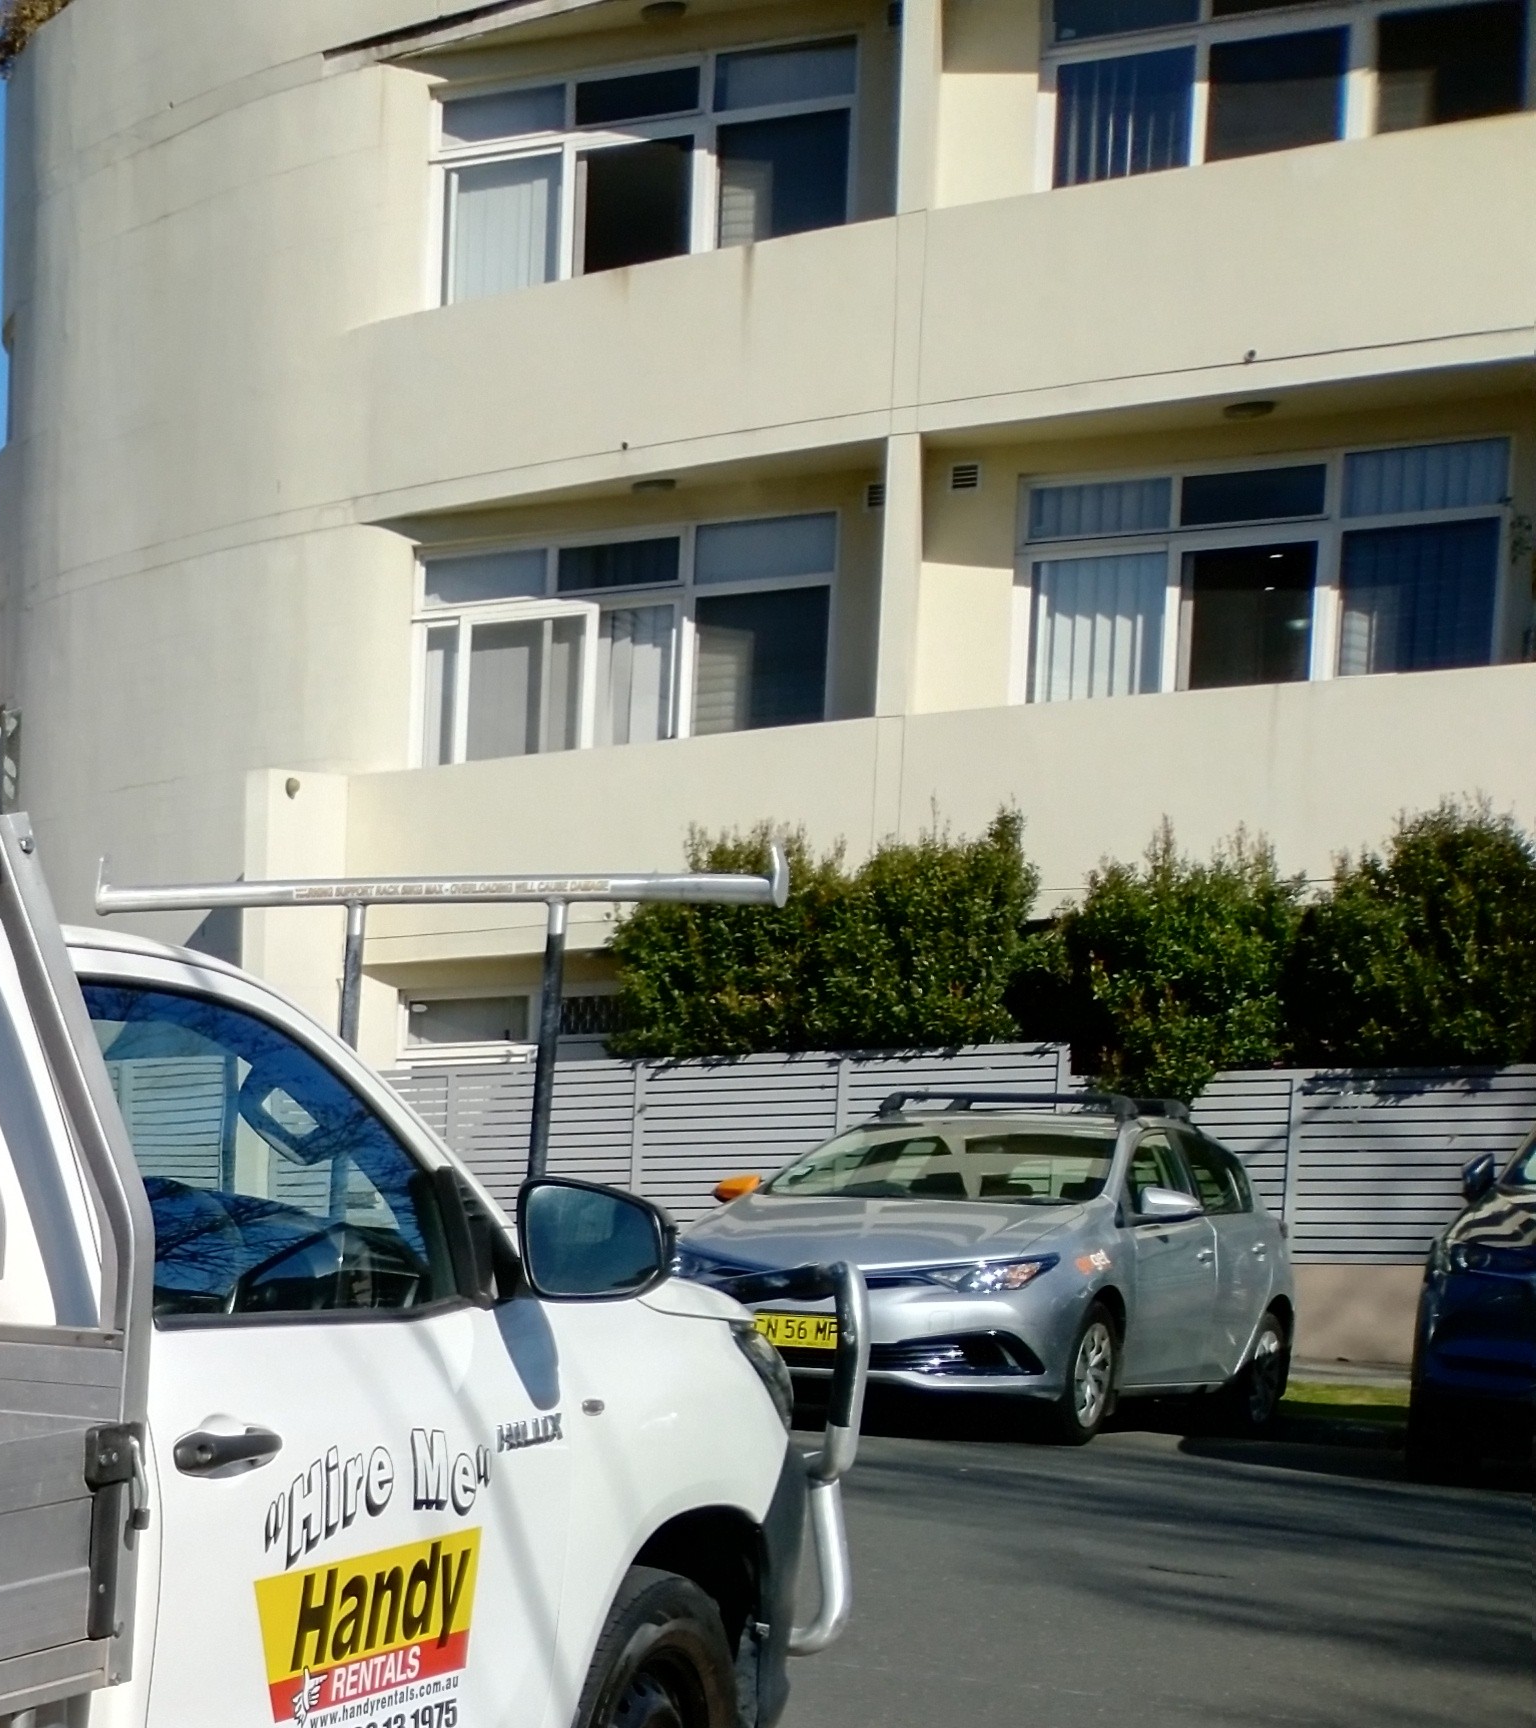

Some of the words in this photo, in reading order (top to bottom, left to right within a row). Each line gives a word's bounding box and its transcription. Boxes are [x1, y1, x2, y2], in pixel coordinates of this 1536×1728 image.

[496, 1412, 564, 1453] HILUX
[290, 1540, 472, 1672] Handy
[331, 1645, 422, 1703] RENTALS
